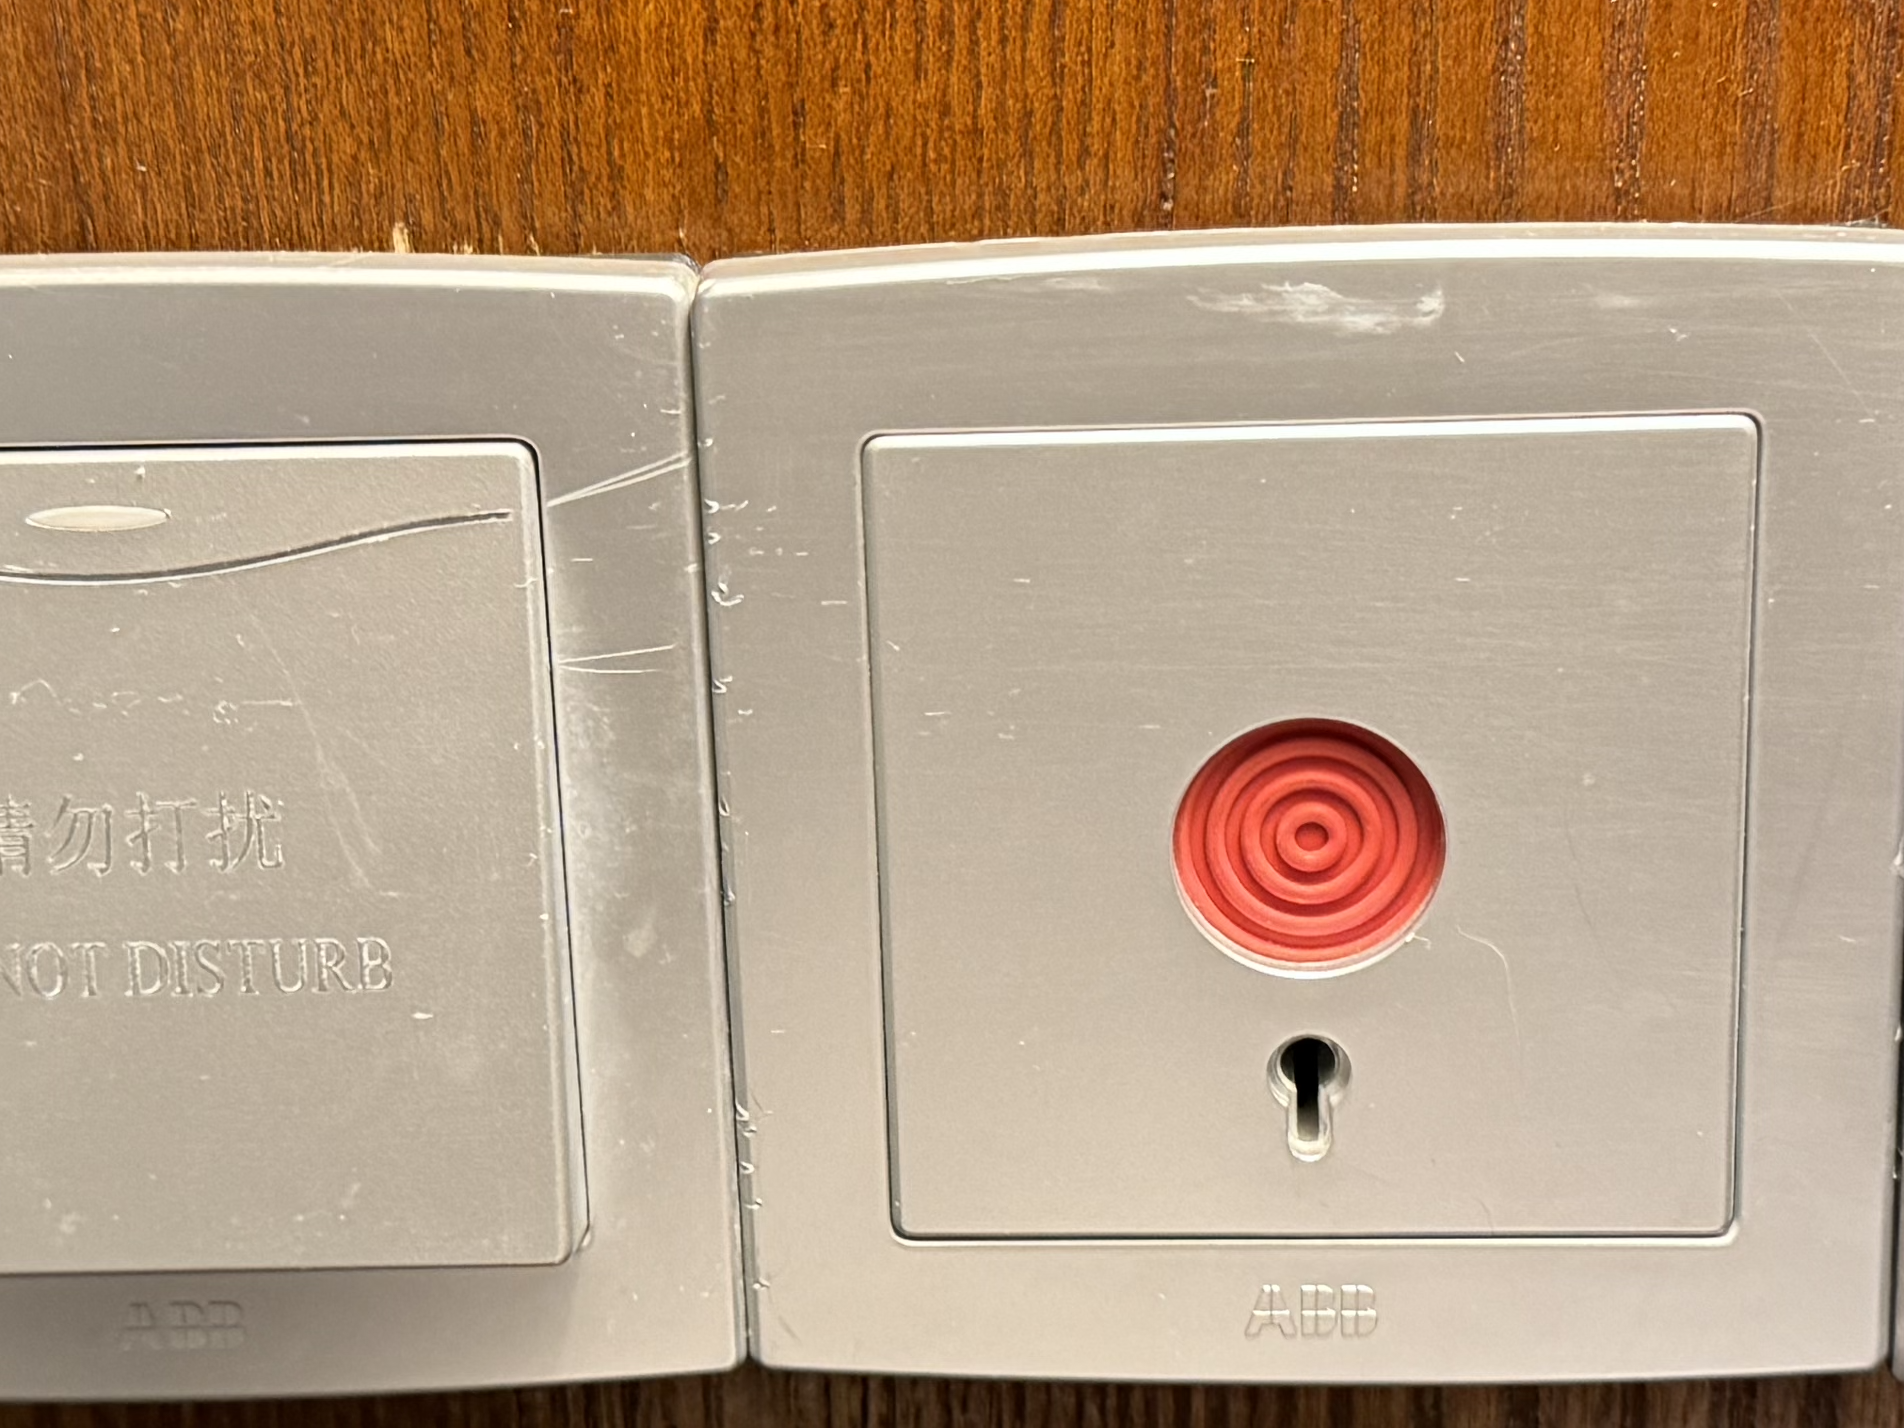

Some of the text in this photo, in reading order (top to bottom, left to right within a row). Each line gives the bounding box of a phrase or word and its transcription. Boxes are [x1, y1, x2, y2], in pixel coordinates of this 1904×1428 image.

[125, 936, 394, 996] DISTURB
[119, 1300, 249, 1352] ABB
[1245, 1283, 1379, 1339] ABB
